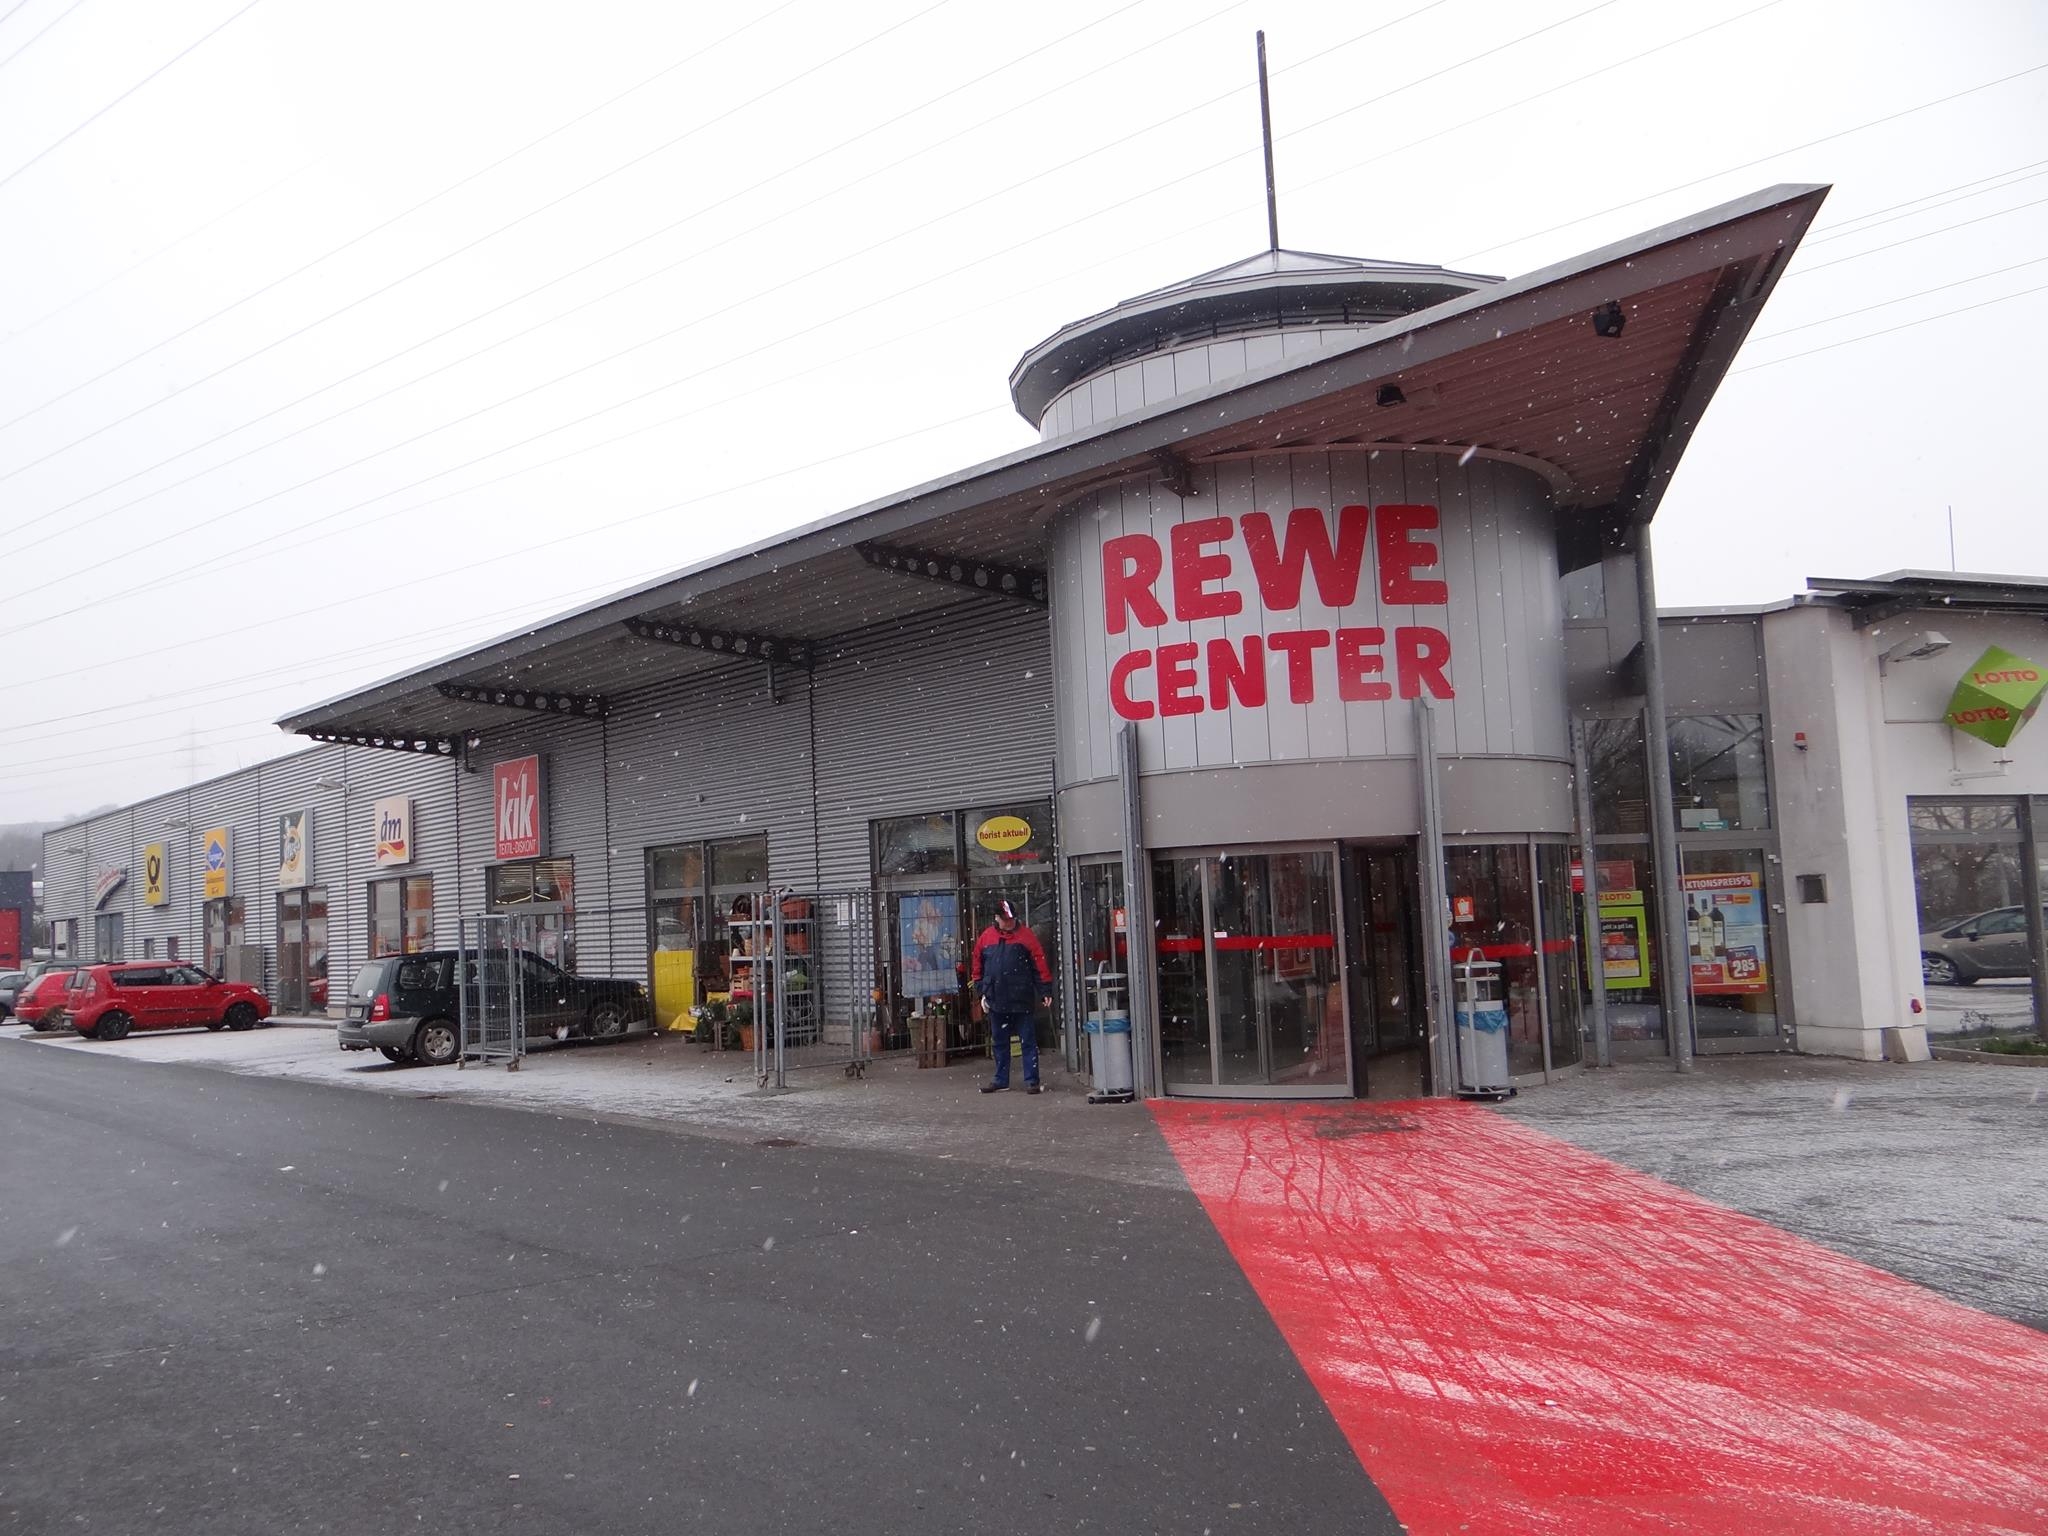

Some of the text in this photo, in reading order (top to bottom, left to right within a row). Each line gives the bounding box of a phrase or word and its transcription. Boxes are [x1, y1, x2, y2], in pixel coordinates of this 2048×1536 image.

[1102, 504, 1449, 636] REWE
[1109, 626, 1456, 721] CENTER
[1973, 670, 2038, 685] LOTTO
[1952, 706, 2010, 725] LOTTO
[380, 810, 401, 842] dm
[979, 828, 1028, 840] florist aktuell
[1605, 893, 1632, 901] LOTTO
